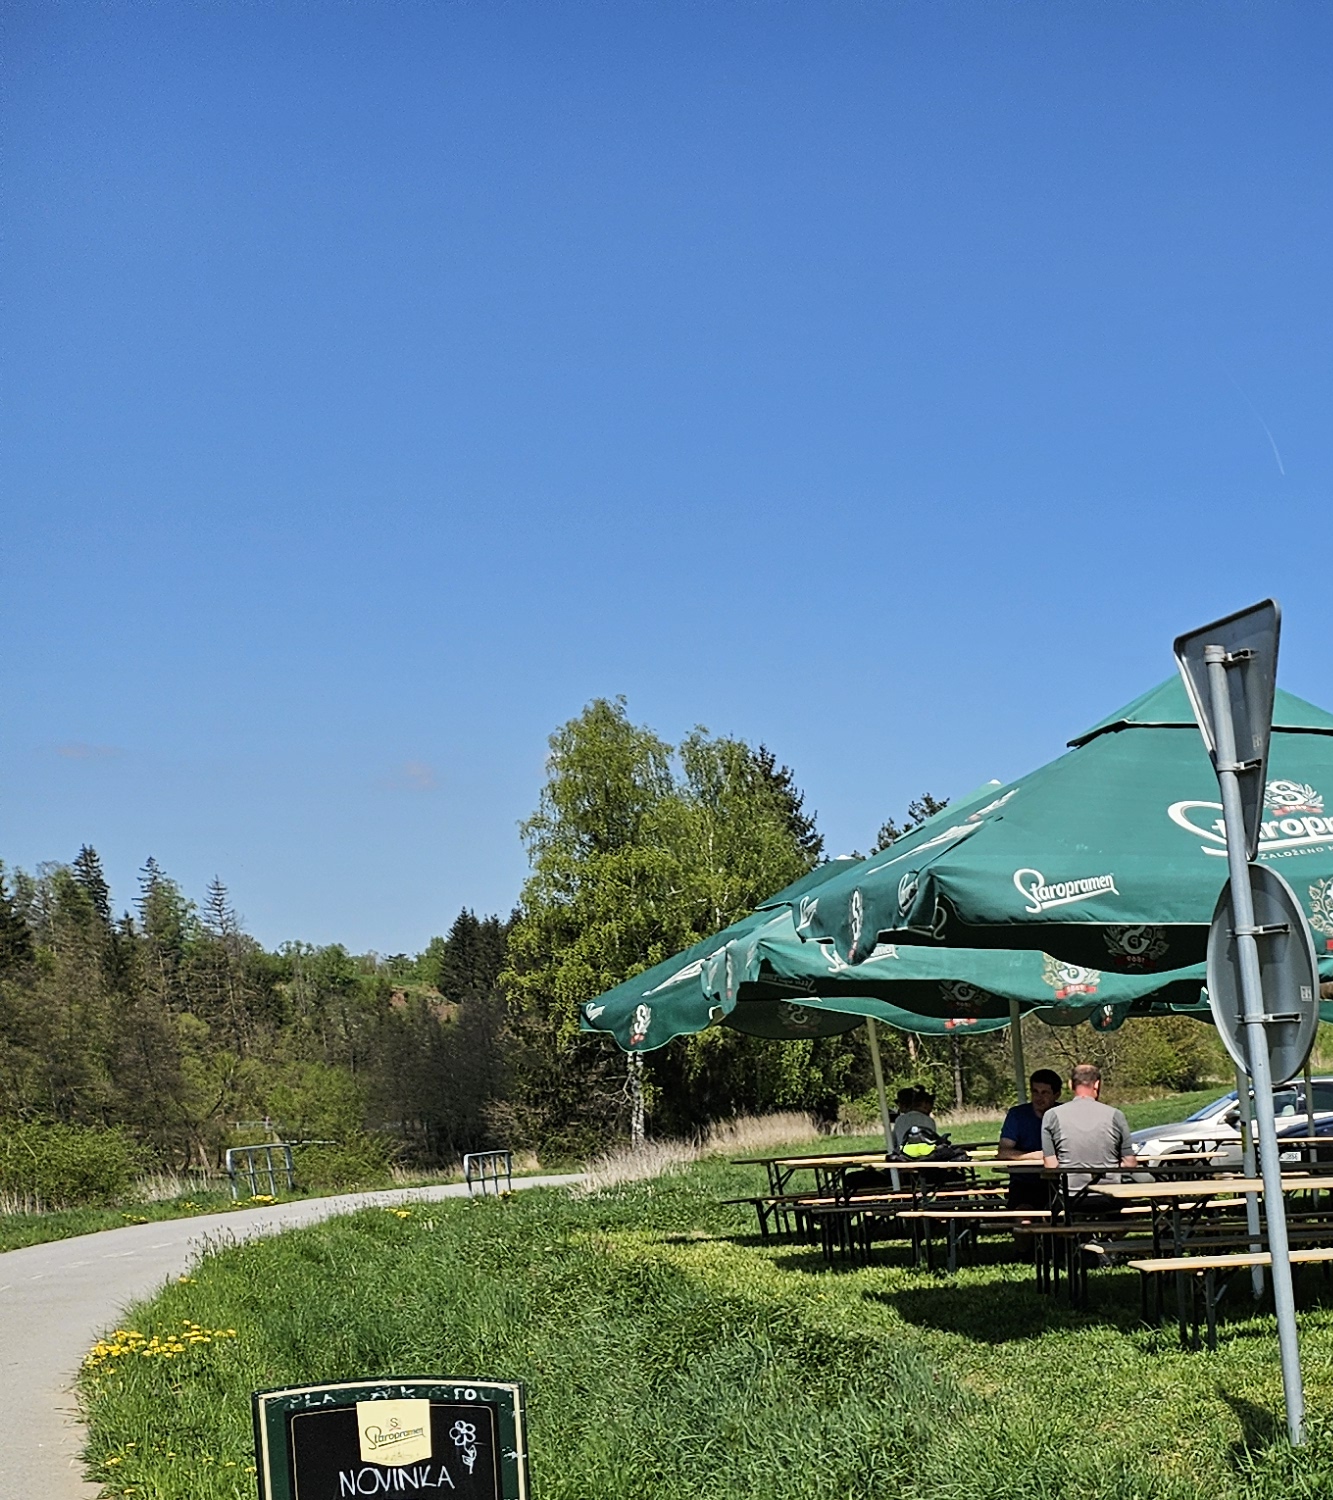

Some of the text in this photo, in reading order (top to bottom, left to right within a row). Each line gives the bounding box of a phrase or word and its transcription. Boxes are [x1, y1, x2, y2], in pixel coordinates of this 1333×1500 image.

[1013, 868, 1120, 914] Staropramen
[364, 1425, 427, 1450] Staropramen
[338, 1464, 455, 1497] NOVINKA
